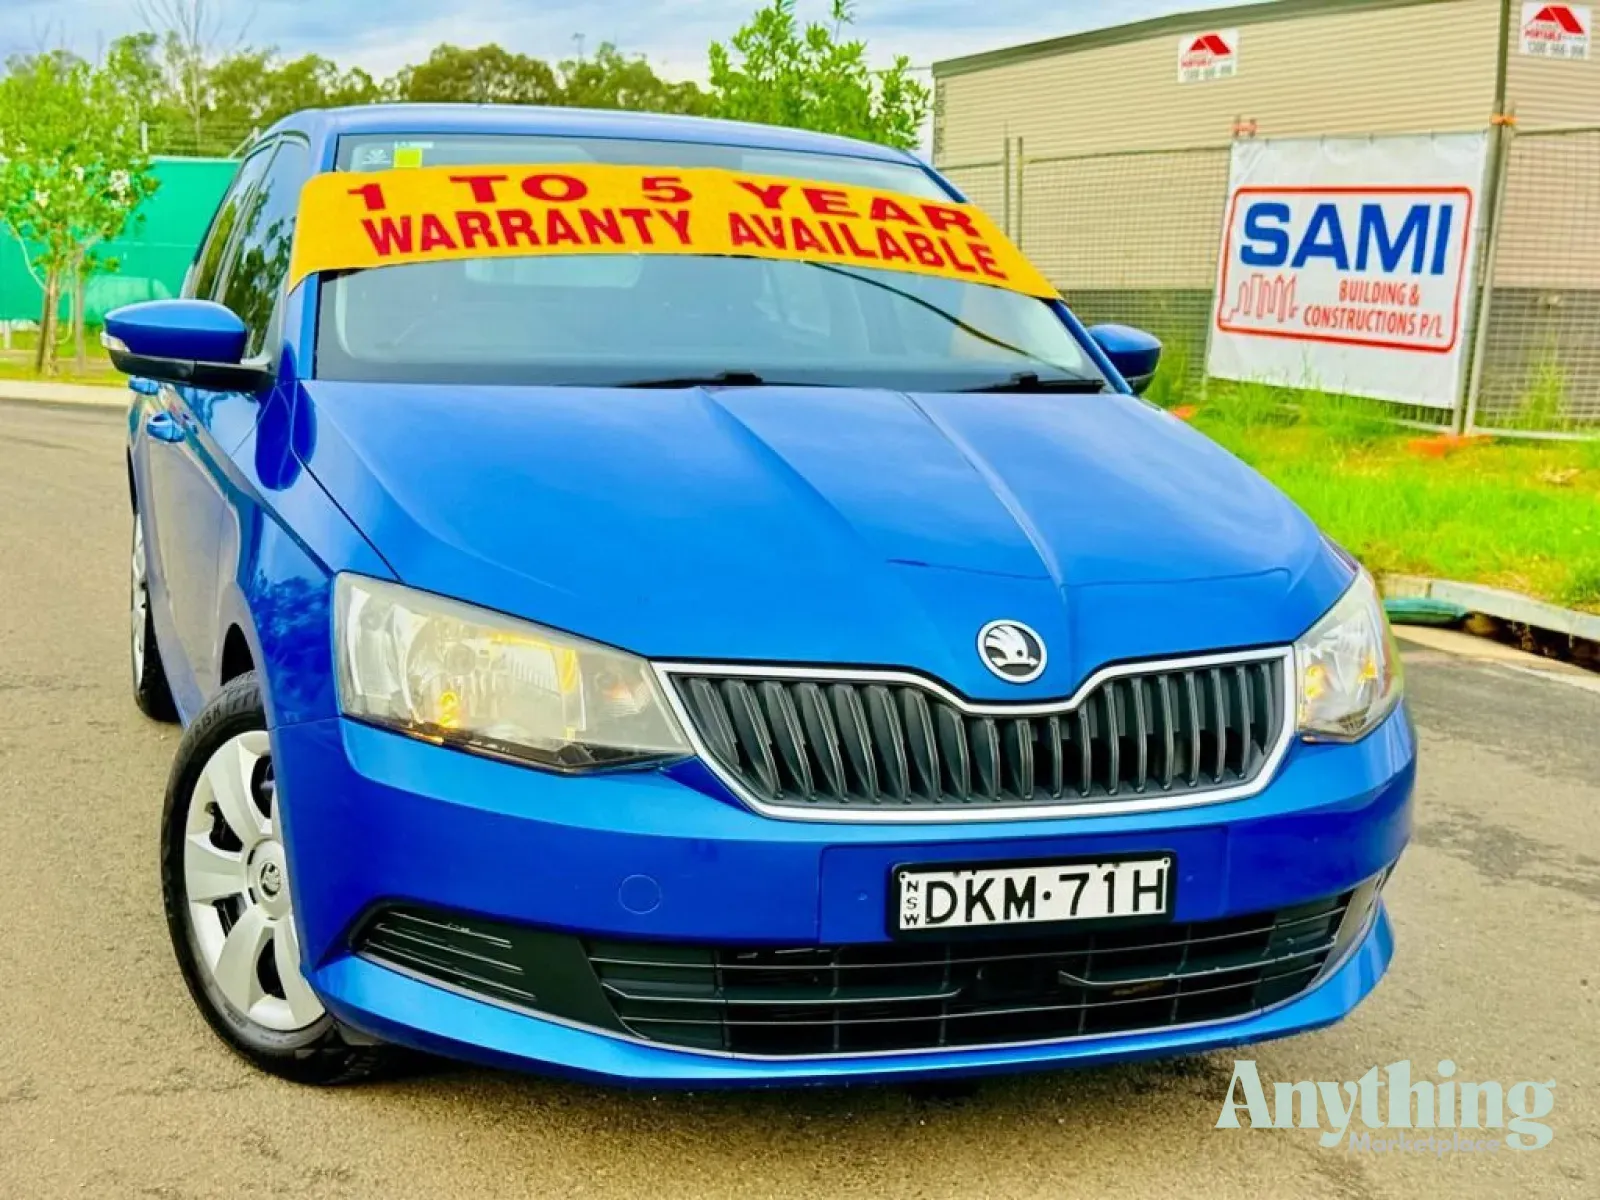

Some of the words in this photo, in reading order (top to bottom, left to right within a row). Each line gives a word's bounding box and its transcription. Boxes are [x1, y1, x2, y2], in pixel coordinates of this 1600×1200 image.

[347, 183, 386, 210] 1
[449, 174, 588, 203] TO
[641, 176, 693, 202] 5
[733, 180, 981, 240] YEAR
[1240, 202, 1453, 275] SAMI
[361, 208, 692, 256] WARRANTY
[728, 212, 1009, 281] AVAILABLE
[1303, 306, 1416, 336] CONSTRUCTIONS
[1418, 314, 1443, 338] P/L
[1338, 280, 1407, 305] BUILDING
[1410, 283, 1421, 307] &
